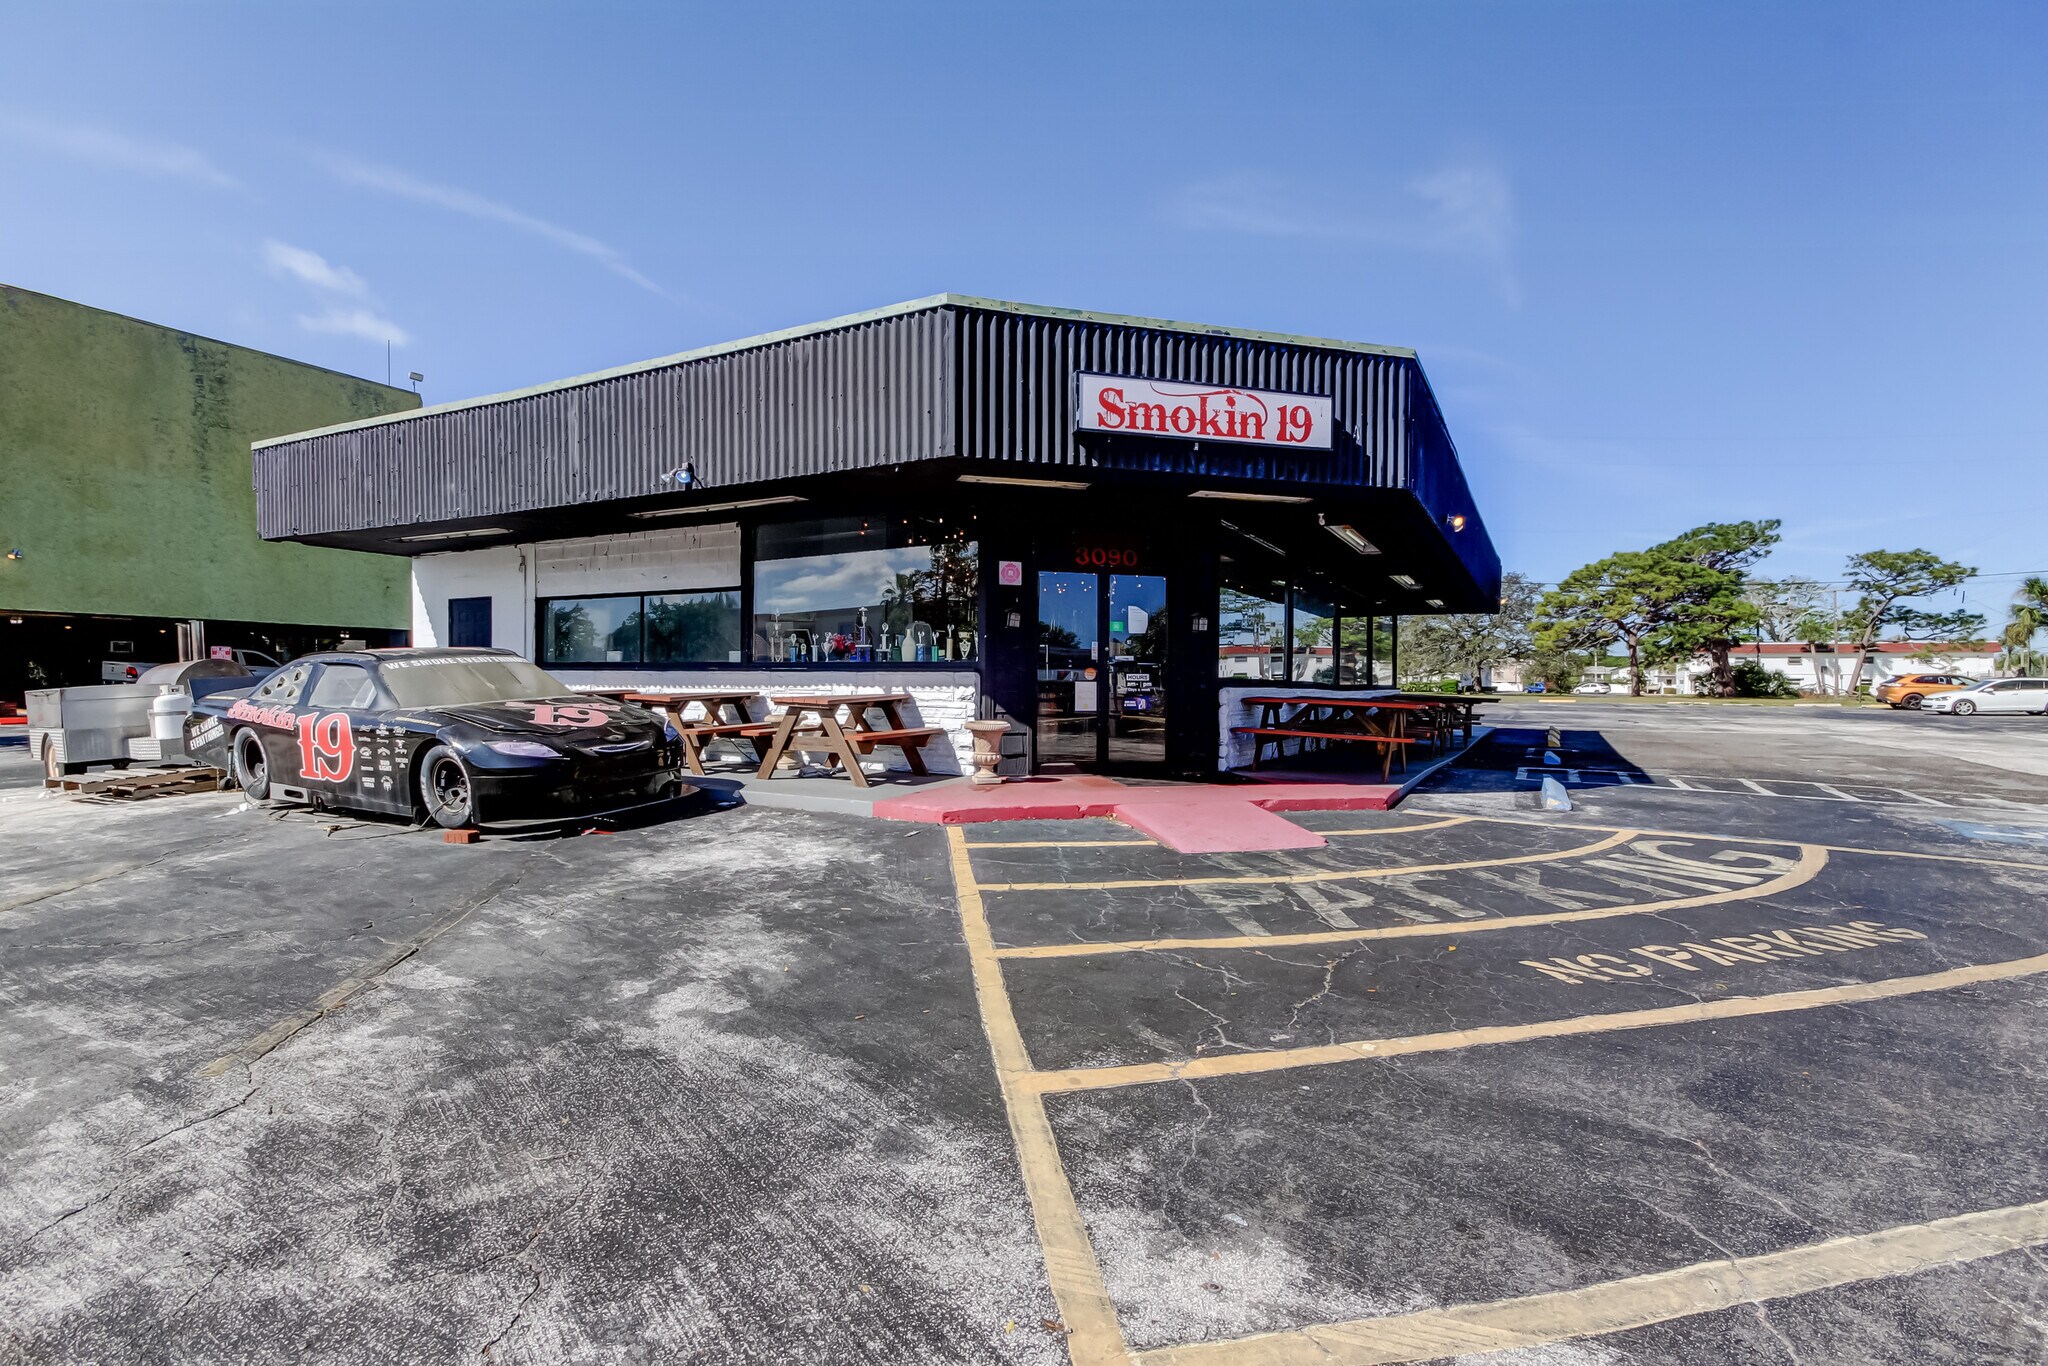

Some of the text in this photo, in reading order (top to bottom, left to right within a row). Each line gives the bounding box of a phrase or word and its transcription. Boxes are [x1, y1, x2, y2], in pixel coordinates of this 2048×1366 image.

[1097, 385, 1313, 443] Smokin 19
[1075, 547, 1138, 567] 3090
[385, 661, 410, 670] WE
[411, 657, 457, 667] SMOKE
[191, 714, 219, 738] WE SMOKE
[528, 704, 612, 728] 19
[227, 699, 357, 783] Smokin 19
[1519, 920, 1929, 985] NO PARKING
